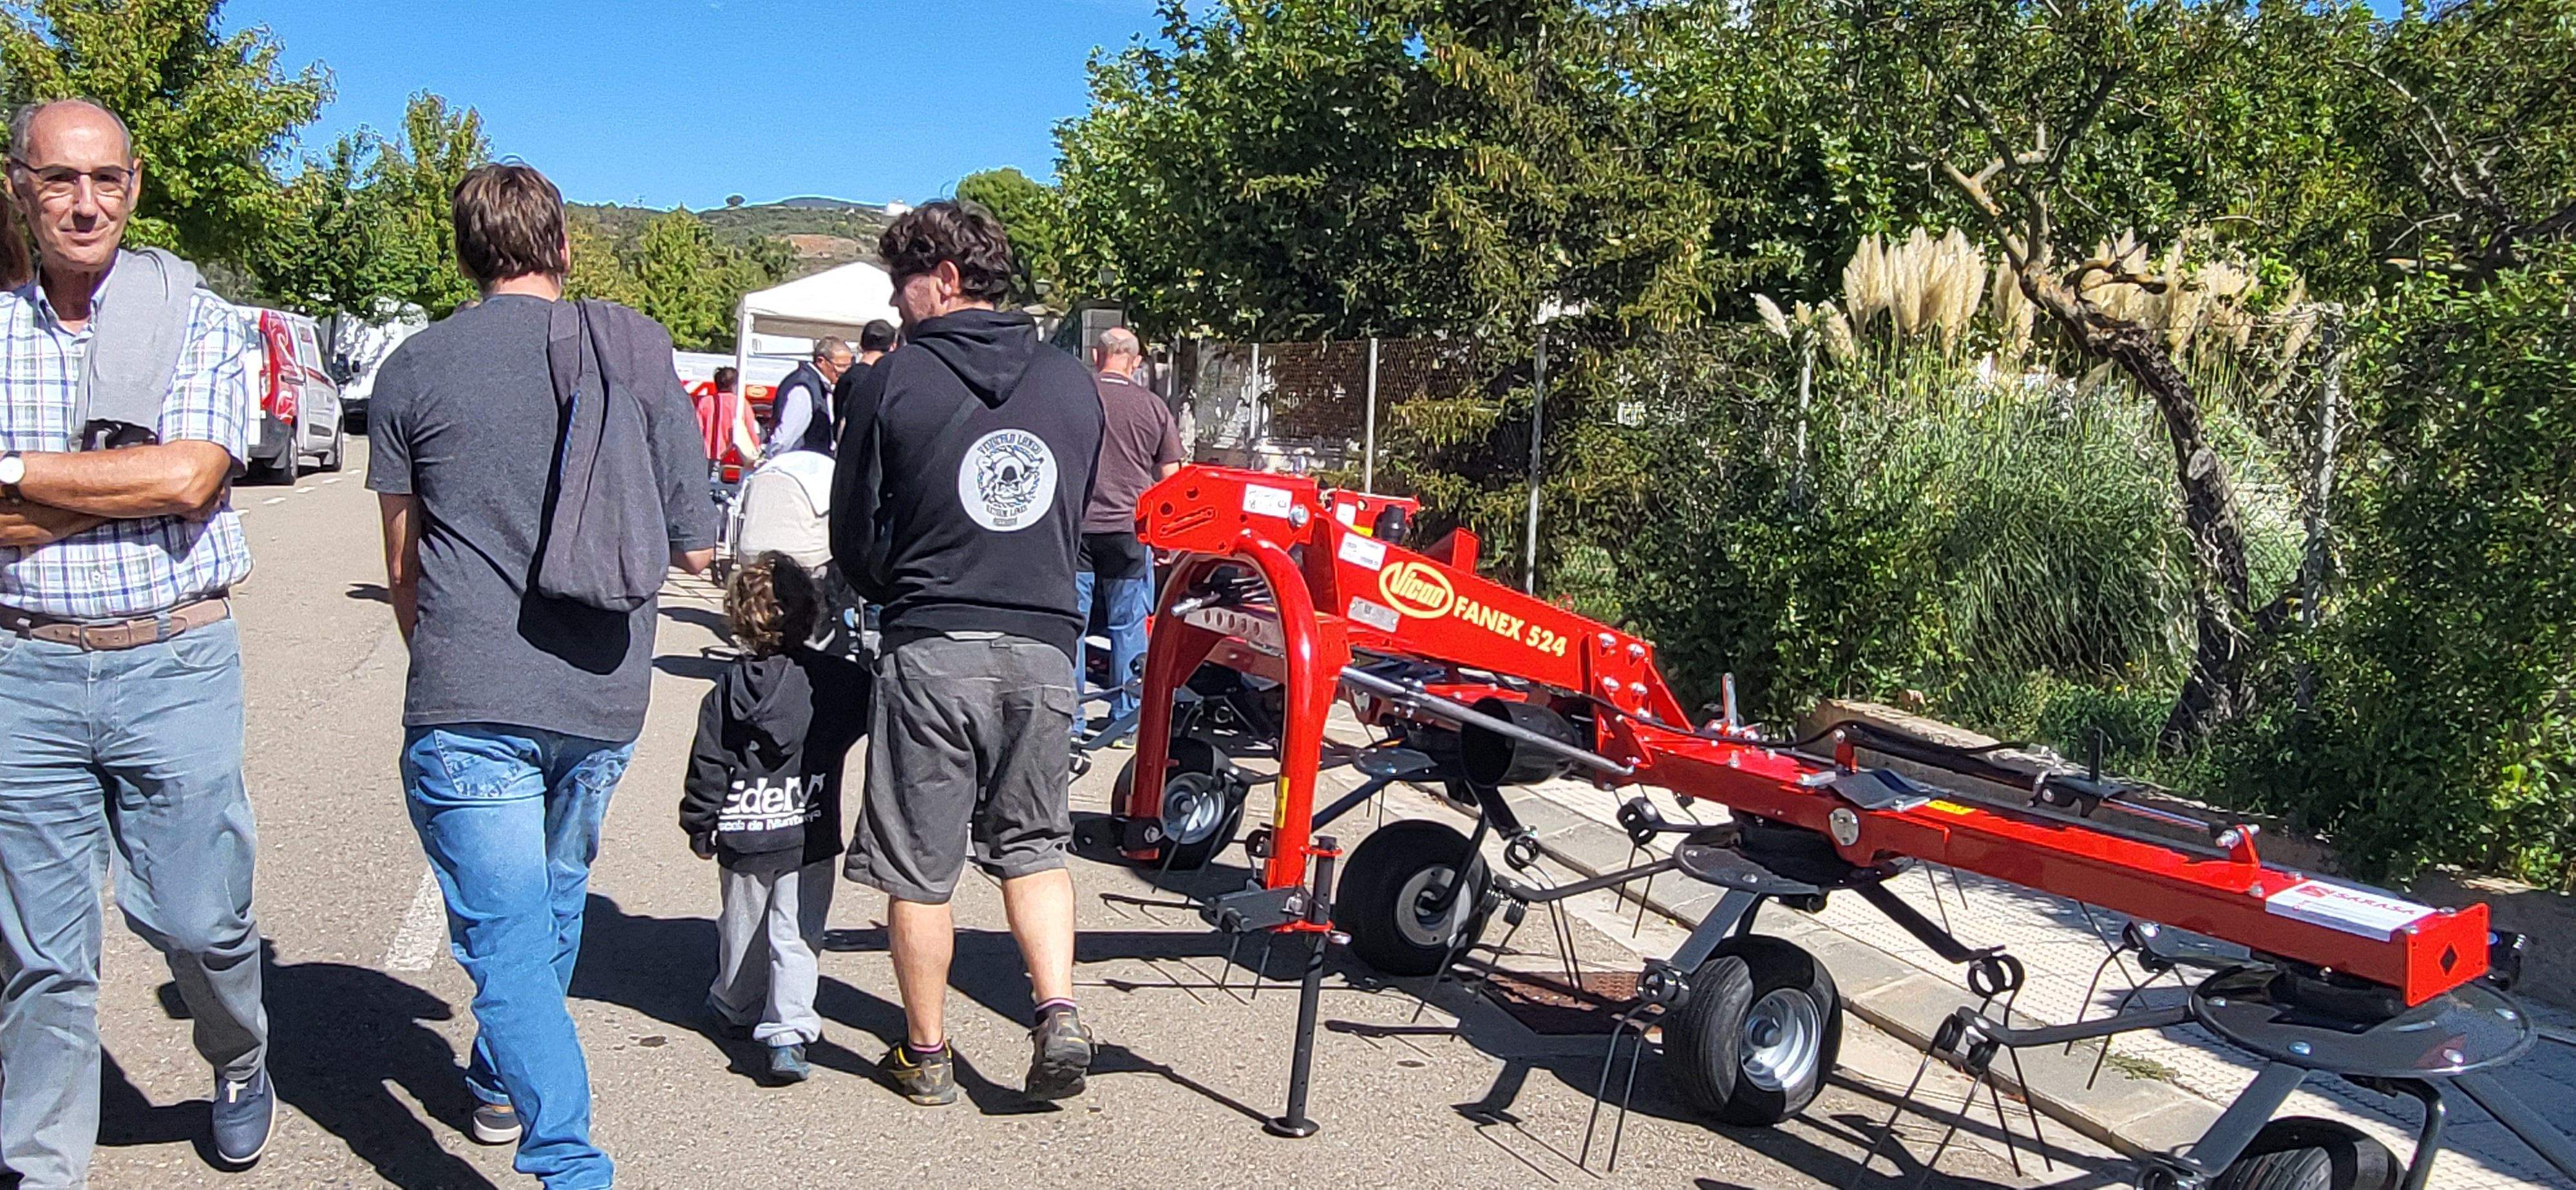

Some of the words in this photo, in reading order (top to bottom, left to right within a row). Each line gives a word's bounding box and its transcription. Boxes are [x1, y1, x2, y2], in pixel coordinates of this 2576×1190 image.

[1389, 561, 1446, 609] Vicon
[1453, 595, 1526, 641] FANEX
[1525, 624, 1567, 657] 524
[2333, 892, 2415, 914] SARASA
